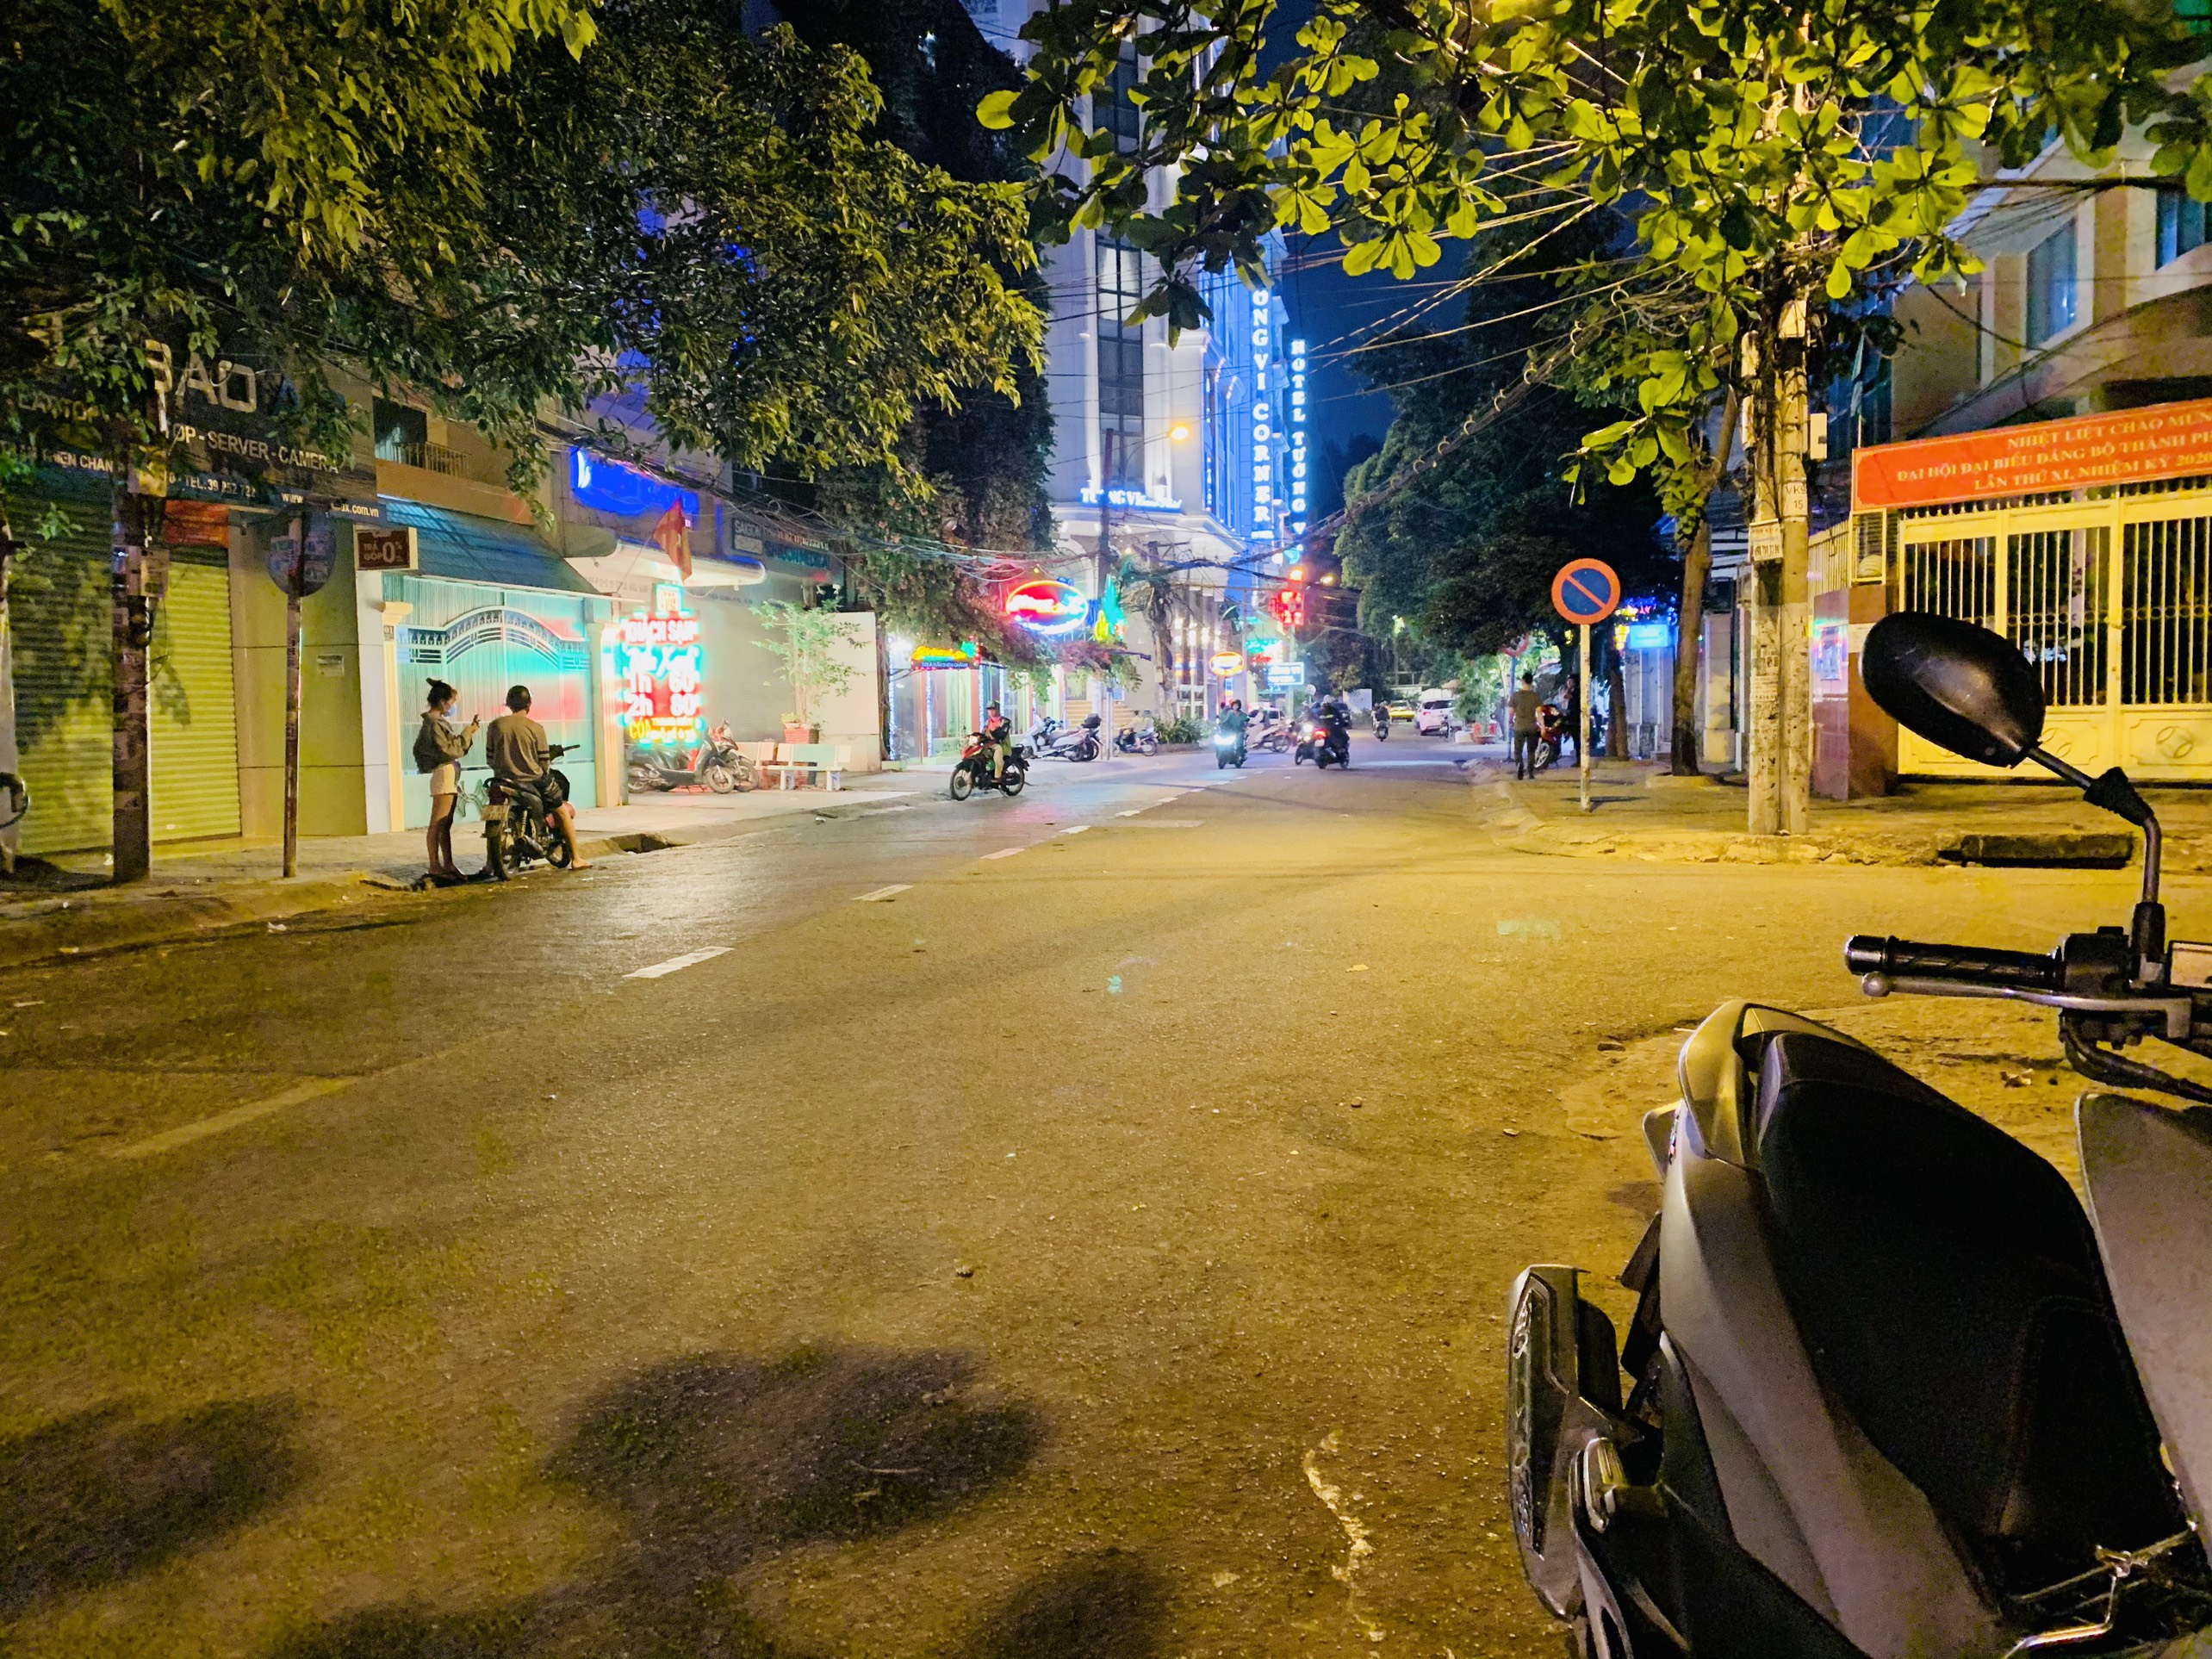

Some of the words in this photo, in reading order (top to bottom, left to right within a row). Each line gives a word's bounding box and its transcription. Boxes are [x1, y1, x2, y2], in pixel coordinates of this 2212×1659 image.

[1291, 340, 1306, 422] HOTEL
[207, 431, 270, 460] SERVER
[278, 445, 339, 474] CAMERA
[1252, 403, 1271, 522] CORNER
[1793, 500, 1804, 510] 15
